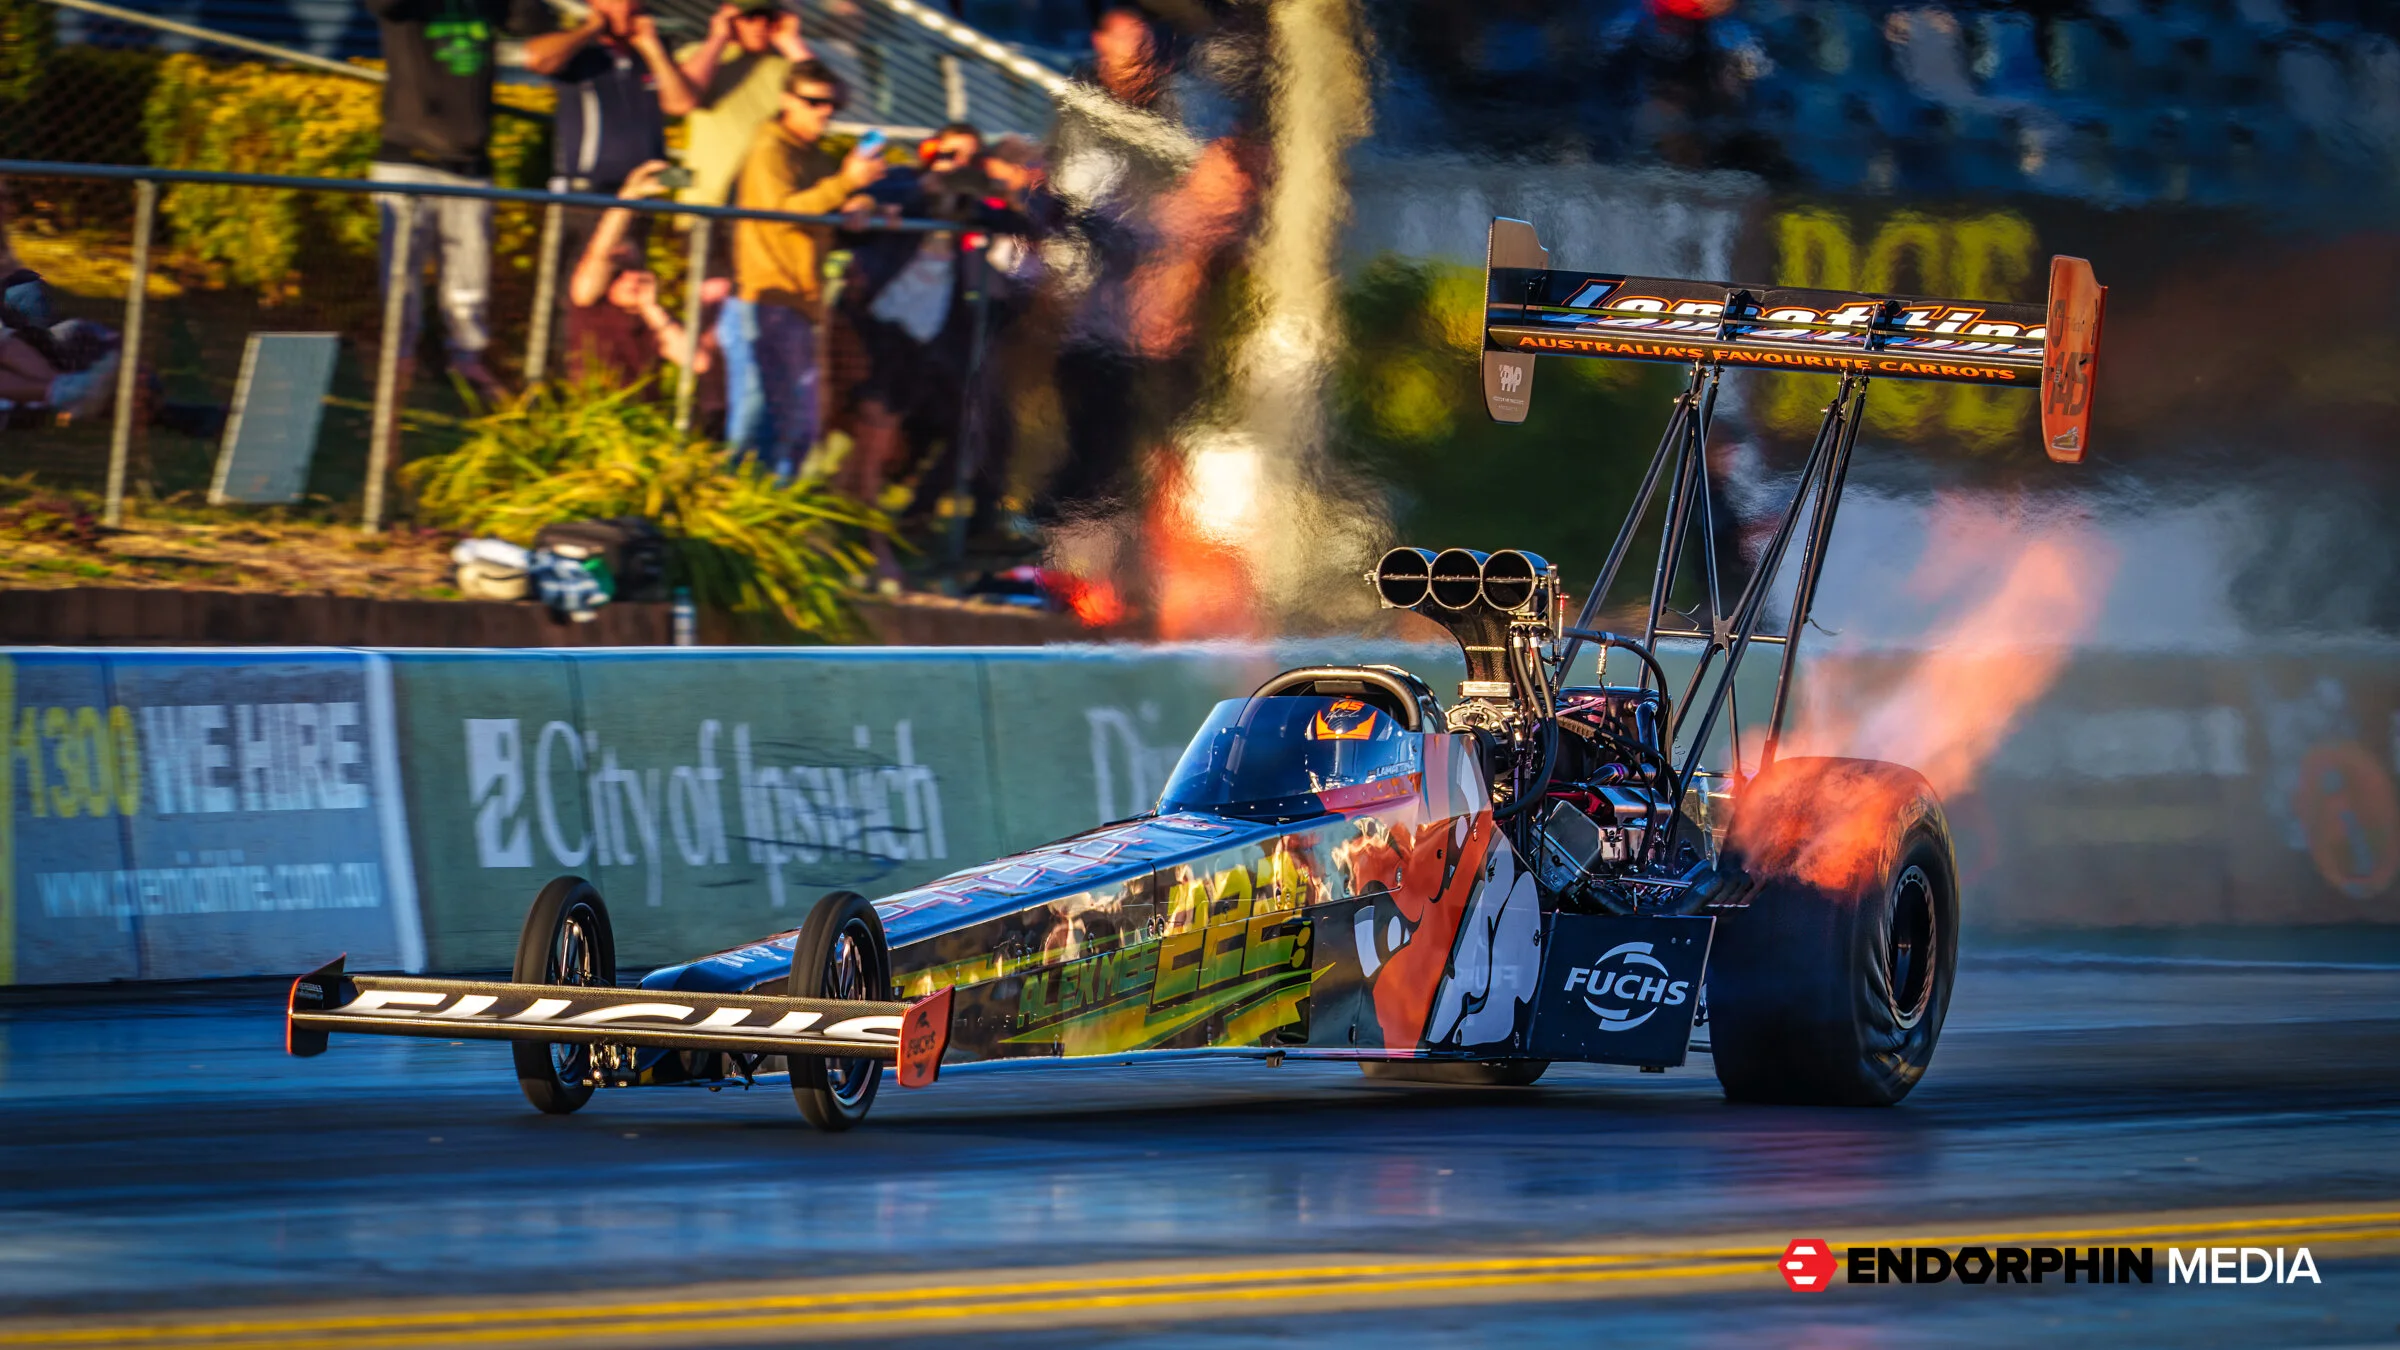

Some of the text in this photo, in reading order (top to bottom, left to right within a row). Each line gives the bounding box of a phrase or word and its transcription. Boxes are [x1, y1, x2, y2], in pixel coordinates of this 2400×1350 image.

[1519, 336, 2016, 379] AUSTRALIA'S FAVOURITE CARROTS
[1330, 700, 1365, 712] 145
[8, 701, 368, 818] 1300 WE HIRE
[536, 719, 661, 907] City
[668, 718, 729, 865] of
[733, 719, 948, 907] Ipswich
[1017, 958, 1097, 1029] ALEX
[1564, 967, 1688, 1005] FUCHS
